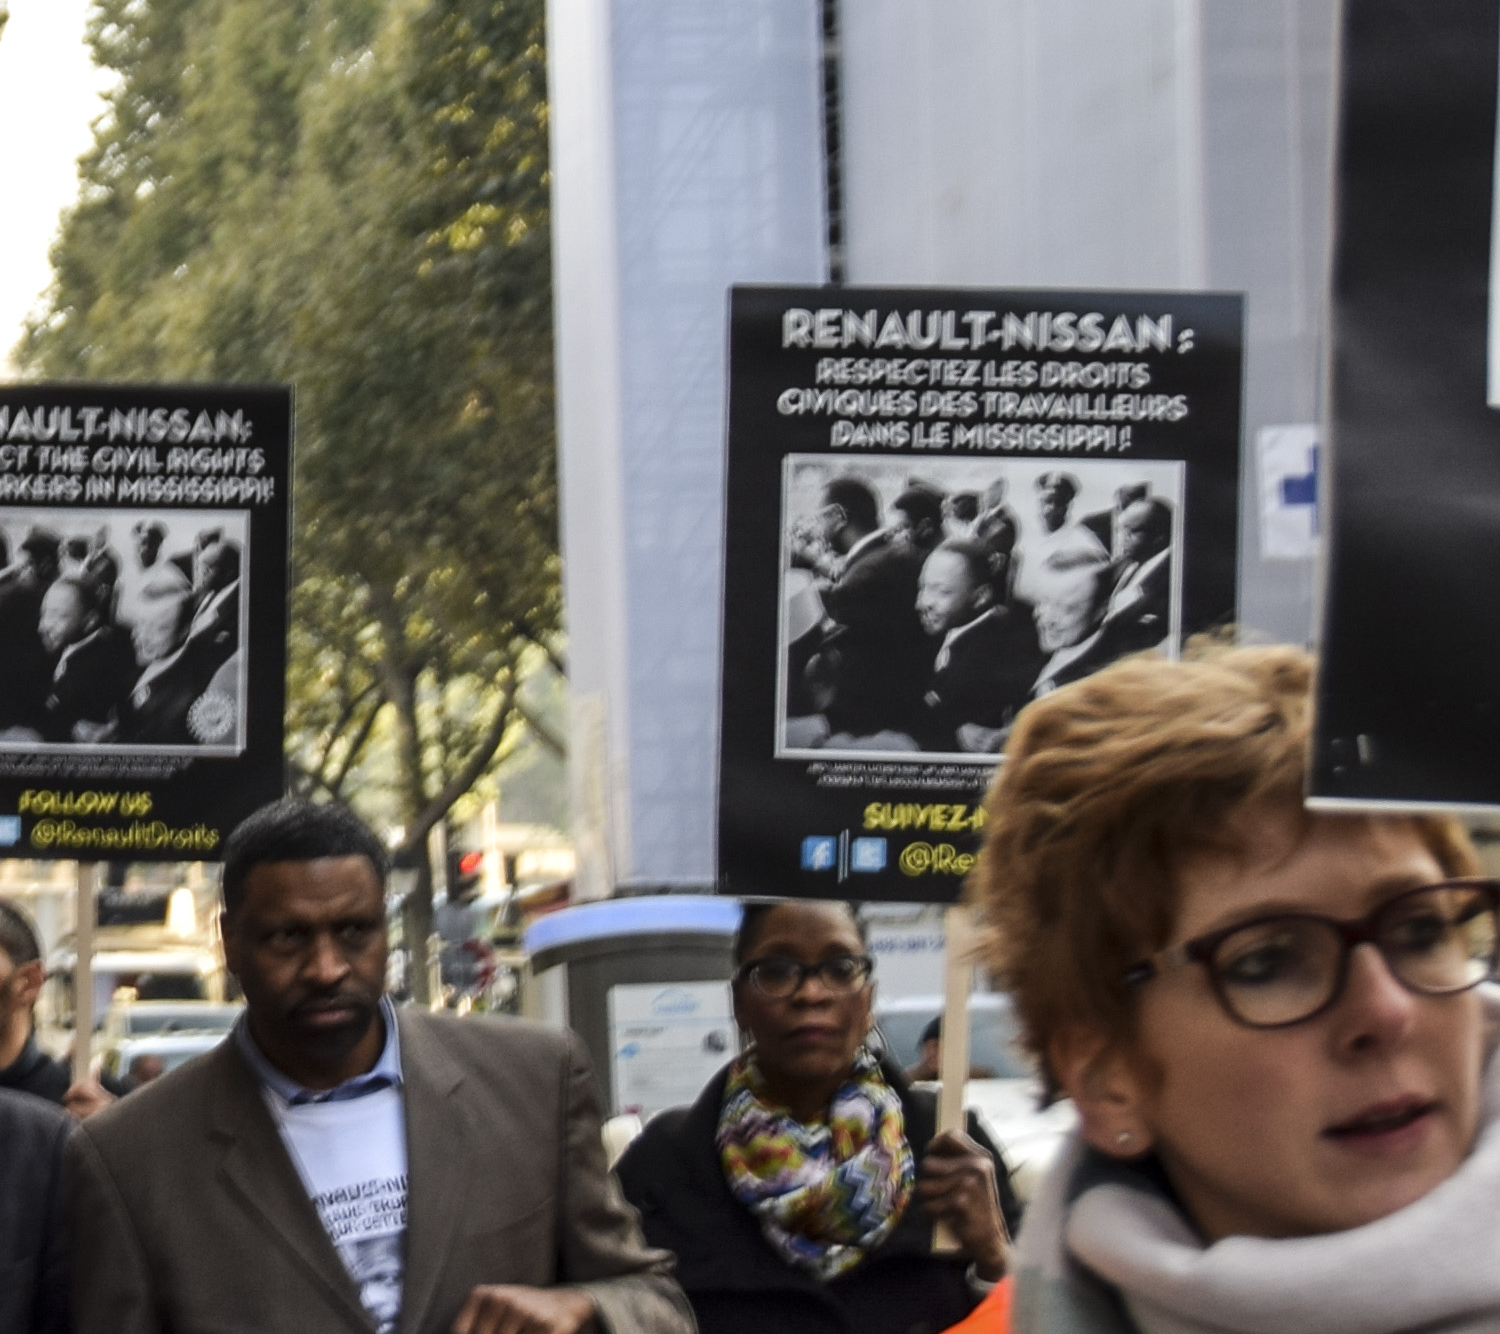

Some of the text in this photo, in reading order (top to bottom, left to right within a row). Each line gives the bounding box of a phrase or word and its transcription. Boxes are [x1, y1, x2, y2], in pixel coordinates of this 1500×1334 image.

[815, 356, 1151, 390] RESPECTEZ LES DROITS
[776, 387, 1190, 422] CIVIQUES DES TRAVAILLEURS
[830, 420, 911, 449] DANS
[912, 421, 951, 448] LE
[34, 445, 91, 472] THE
[92, 445, 165, 473] CIVIL
[166, 446, 267, 476] RIGHTS
[85, 475, 116, 502] IN
[117, 475, 275, 504] MISSISSIPPI!
[18, 788, 154, 816] FOLLOW US
[30, 817, 220, 850] @RenaultDroits
